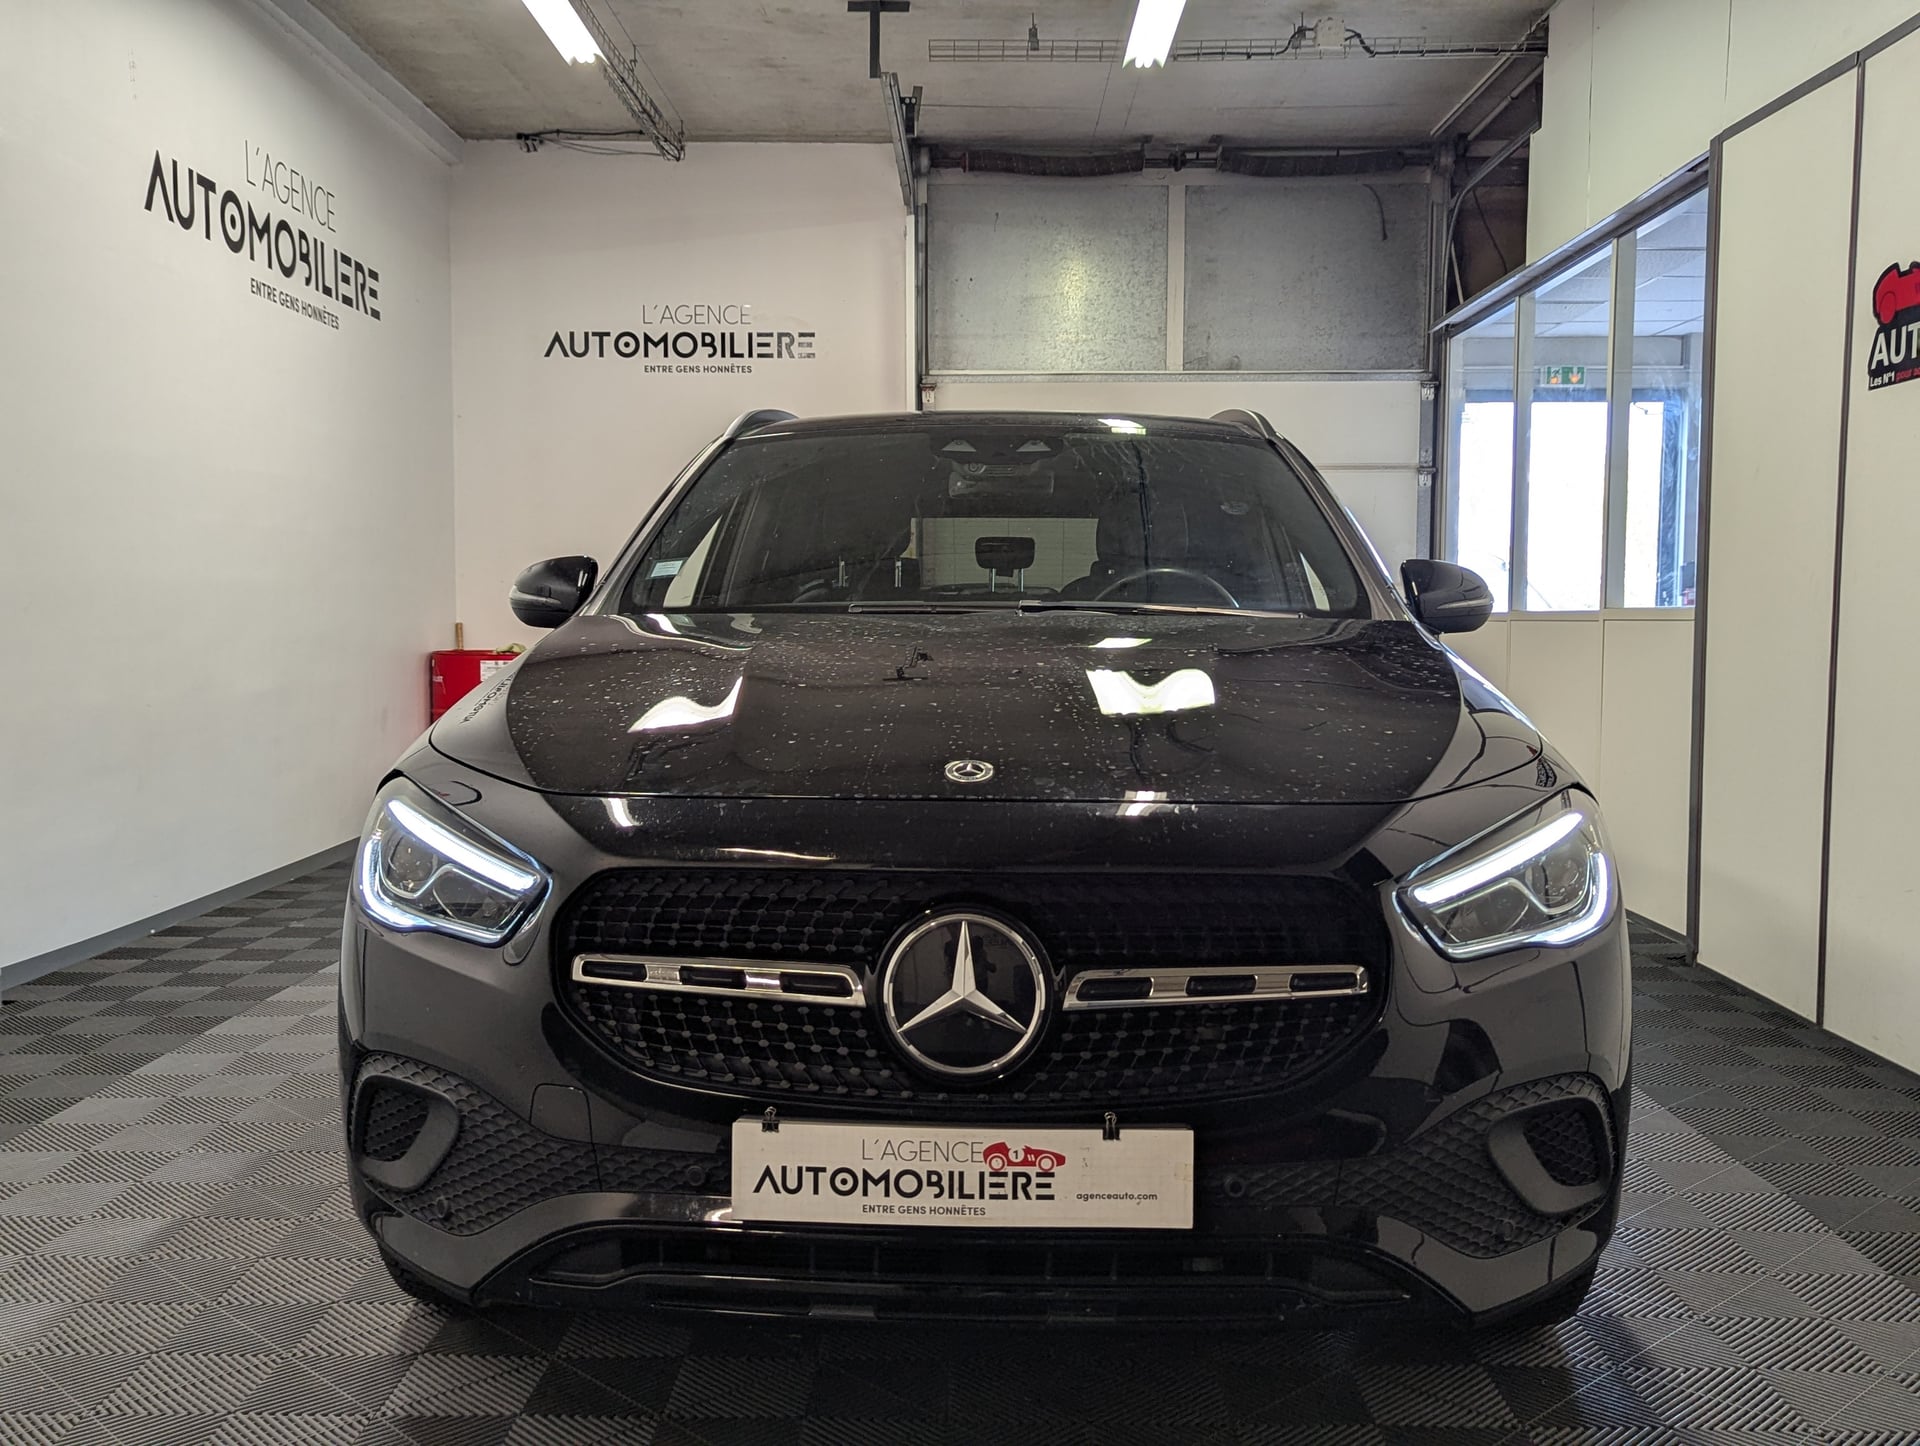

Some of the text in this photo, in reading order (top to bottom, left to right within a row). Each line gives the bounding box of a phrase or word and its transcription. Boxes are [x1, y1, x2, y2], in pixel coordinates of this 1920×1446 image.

[244, 139, 337, 234] L'AGENCE
[144, 149, 382, 322] AUTOMOBILIERE
[250, 277, 340, 331] ENTRE GENS HONNÊTES
[642, 303, 752, 325] L'AGENCE
[543, 330, 816, 359] AUTOMOBILIERE
[643, 362, 753, 374] ENTRE GENS HONNÊTES
[861, 1138, 984, 1164] L'AGENCE
[1013, 1149, 1019, 1160] 1
[752, 1164, 1056, 1201] AUTOMOBILIERE
[862, 1203, 986, 1216] ENTRE GENS HONNÊTES
[1076, 1192, 1158, 1202] agenceauto.com
